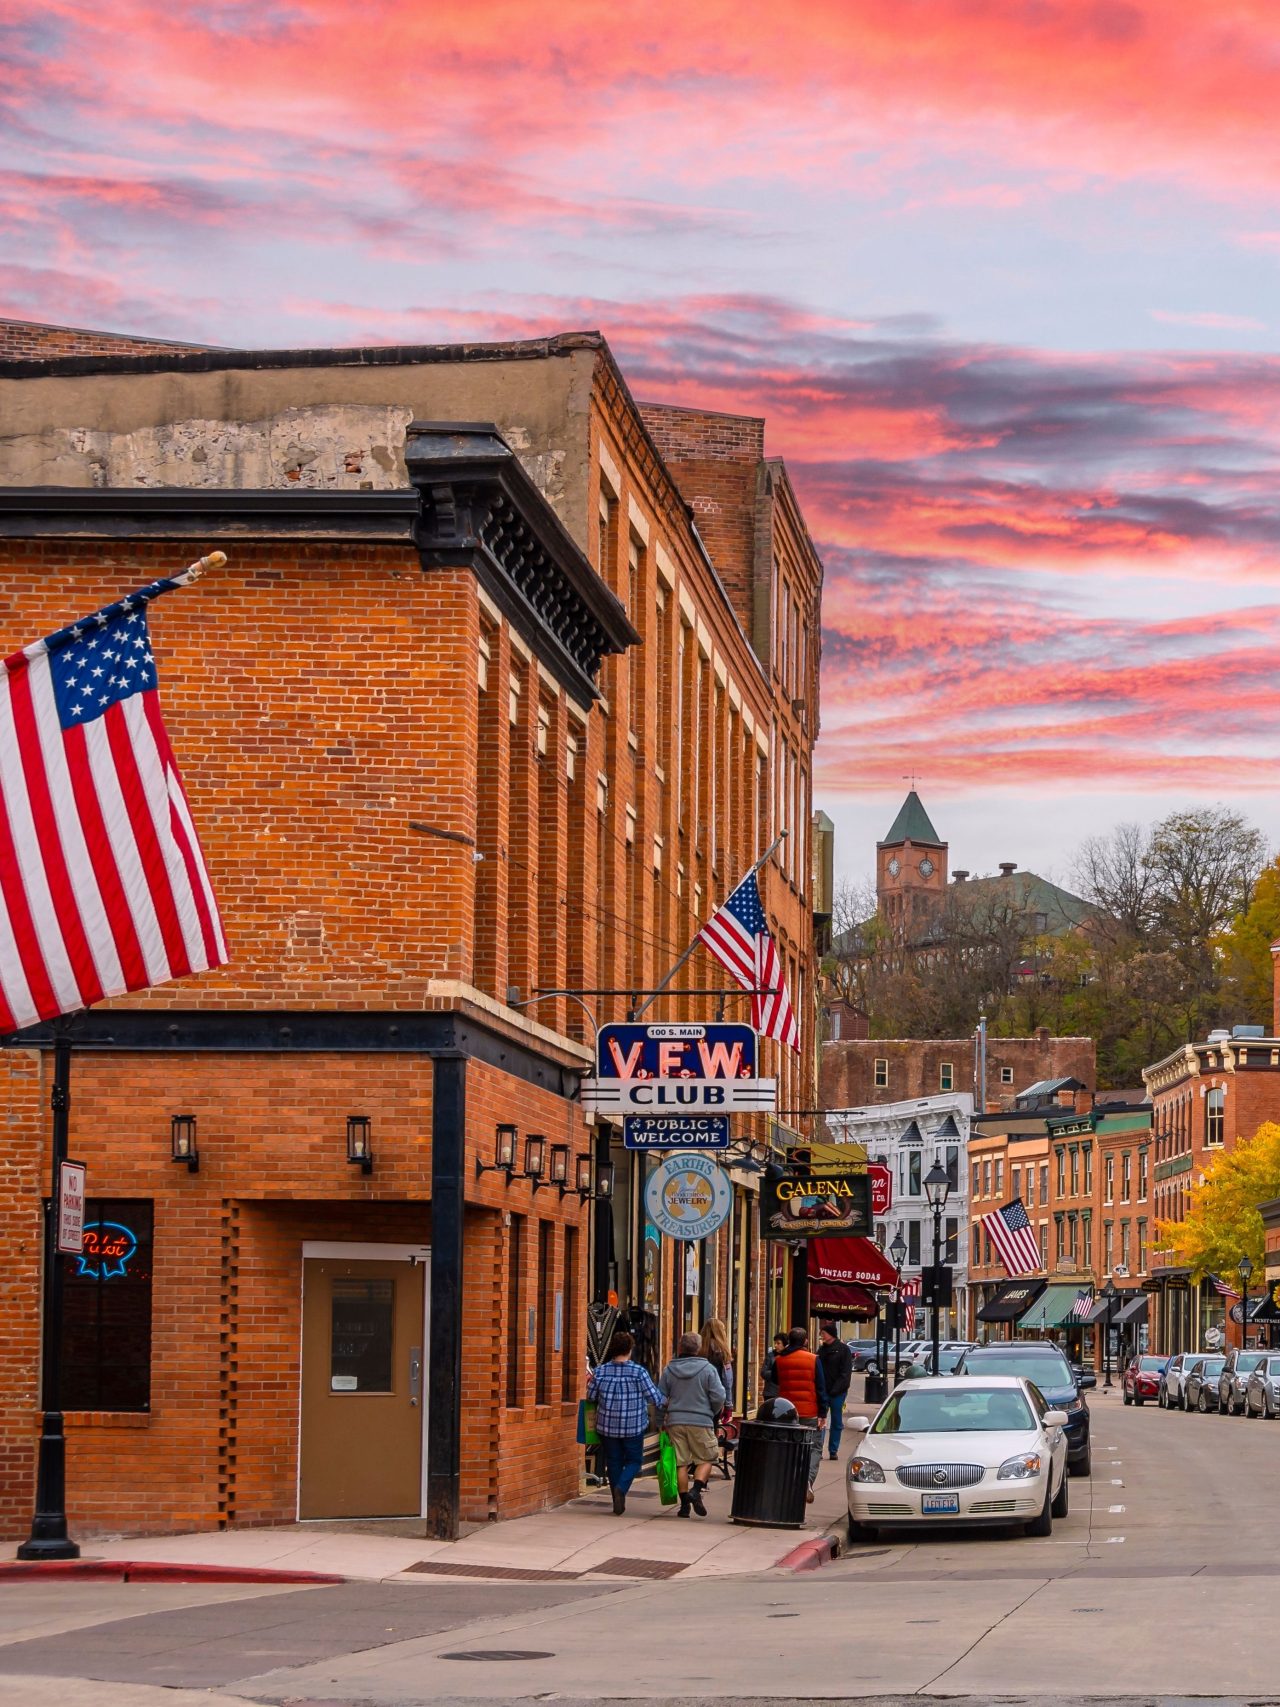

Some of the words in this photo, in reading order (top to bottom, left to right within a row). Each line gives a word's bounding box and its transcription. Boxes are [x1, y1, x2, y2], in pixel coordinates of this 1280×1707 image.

[650, 1028, 667, 1036] 100
[669, 1028, 677, 1036] S.
[679, 1028, 704, 1036] MAIN
[628, 1085, 726, 1105] CLUB
[645, 1118, 709, 1130] PUBLIC
[633, 1131, 721, 1143] WELCOME
[664, 1158, 715, 1176] EARTH'S
[68, 1174, 78, 1192] NO
[775, 1180, 855, 1201] GALENA
[667, 1197, 708, 1205] JEWELRY
[654, 1210, 721, 1237] TREASURES
[819, 1267, 853, 1279] VINTAGE
[855, 1271, 881, 1281] SODAS
